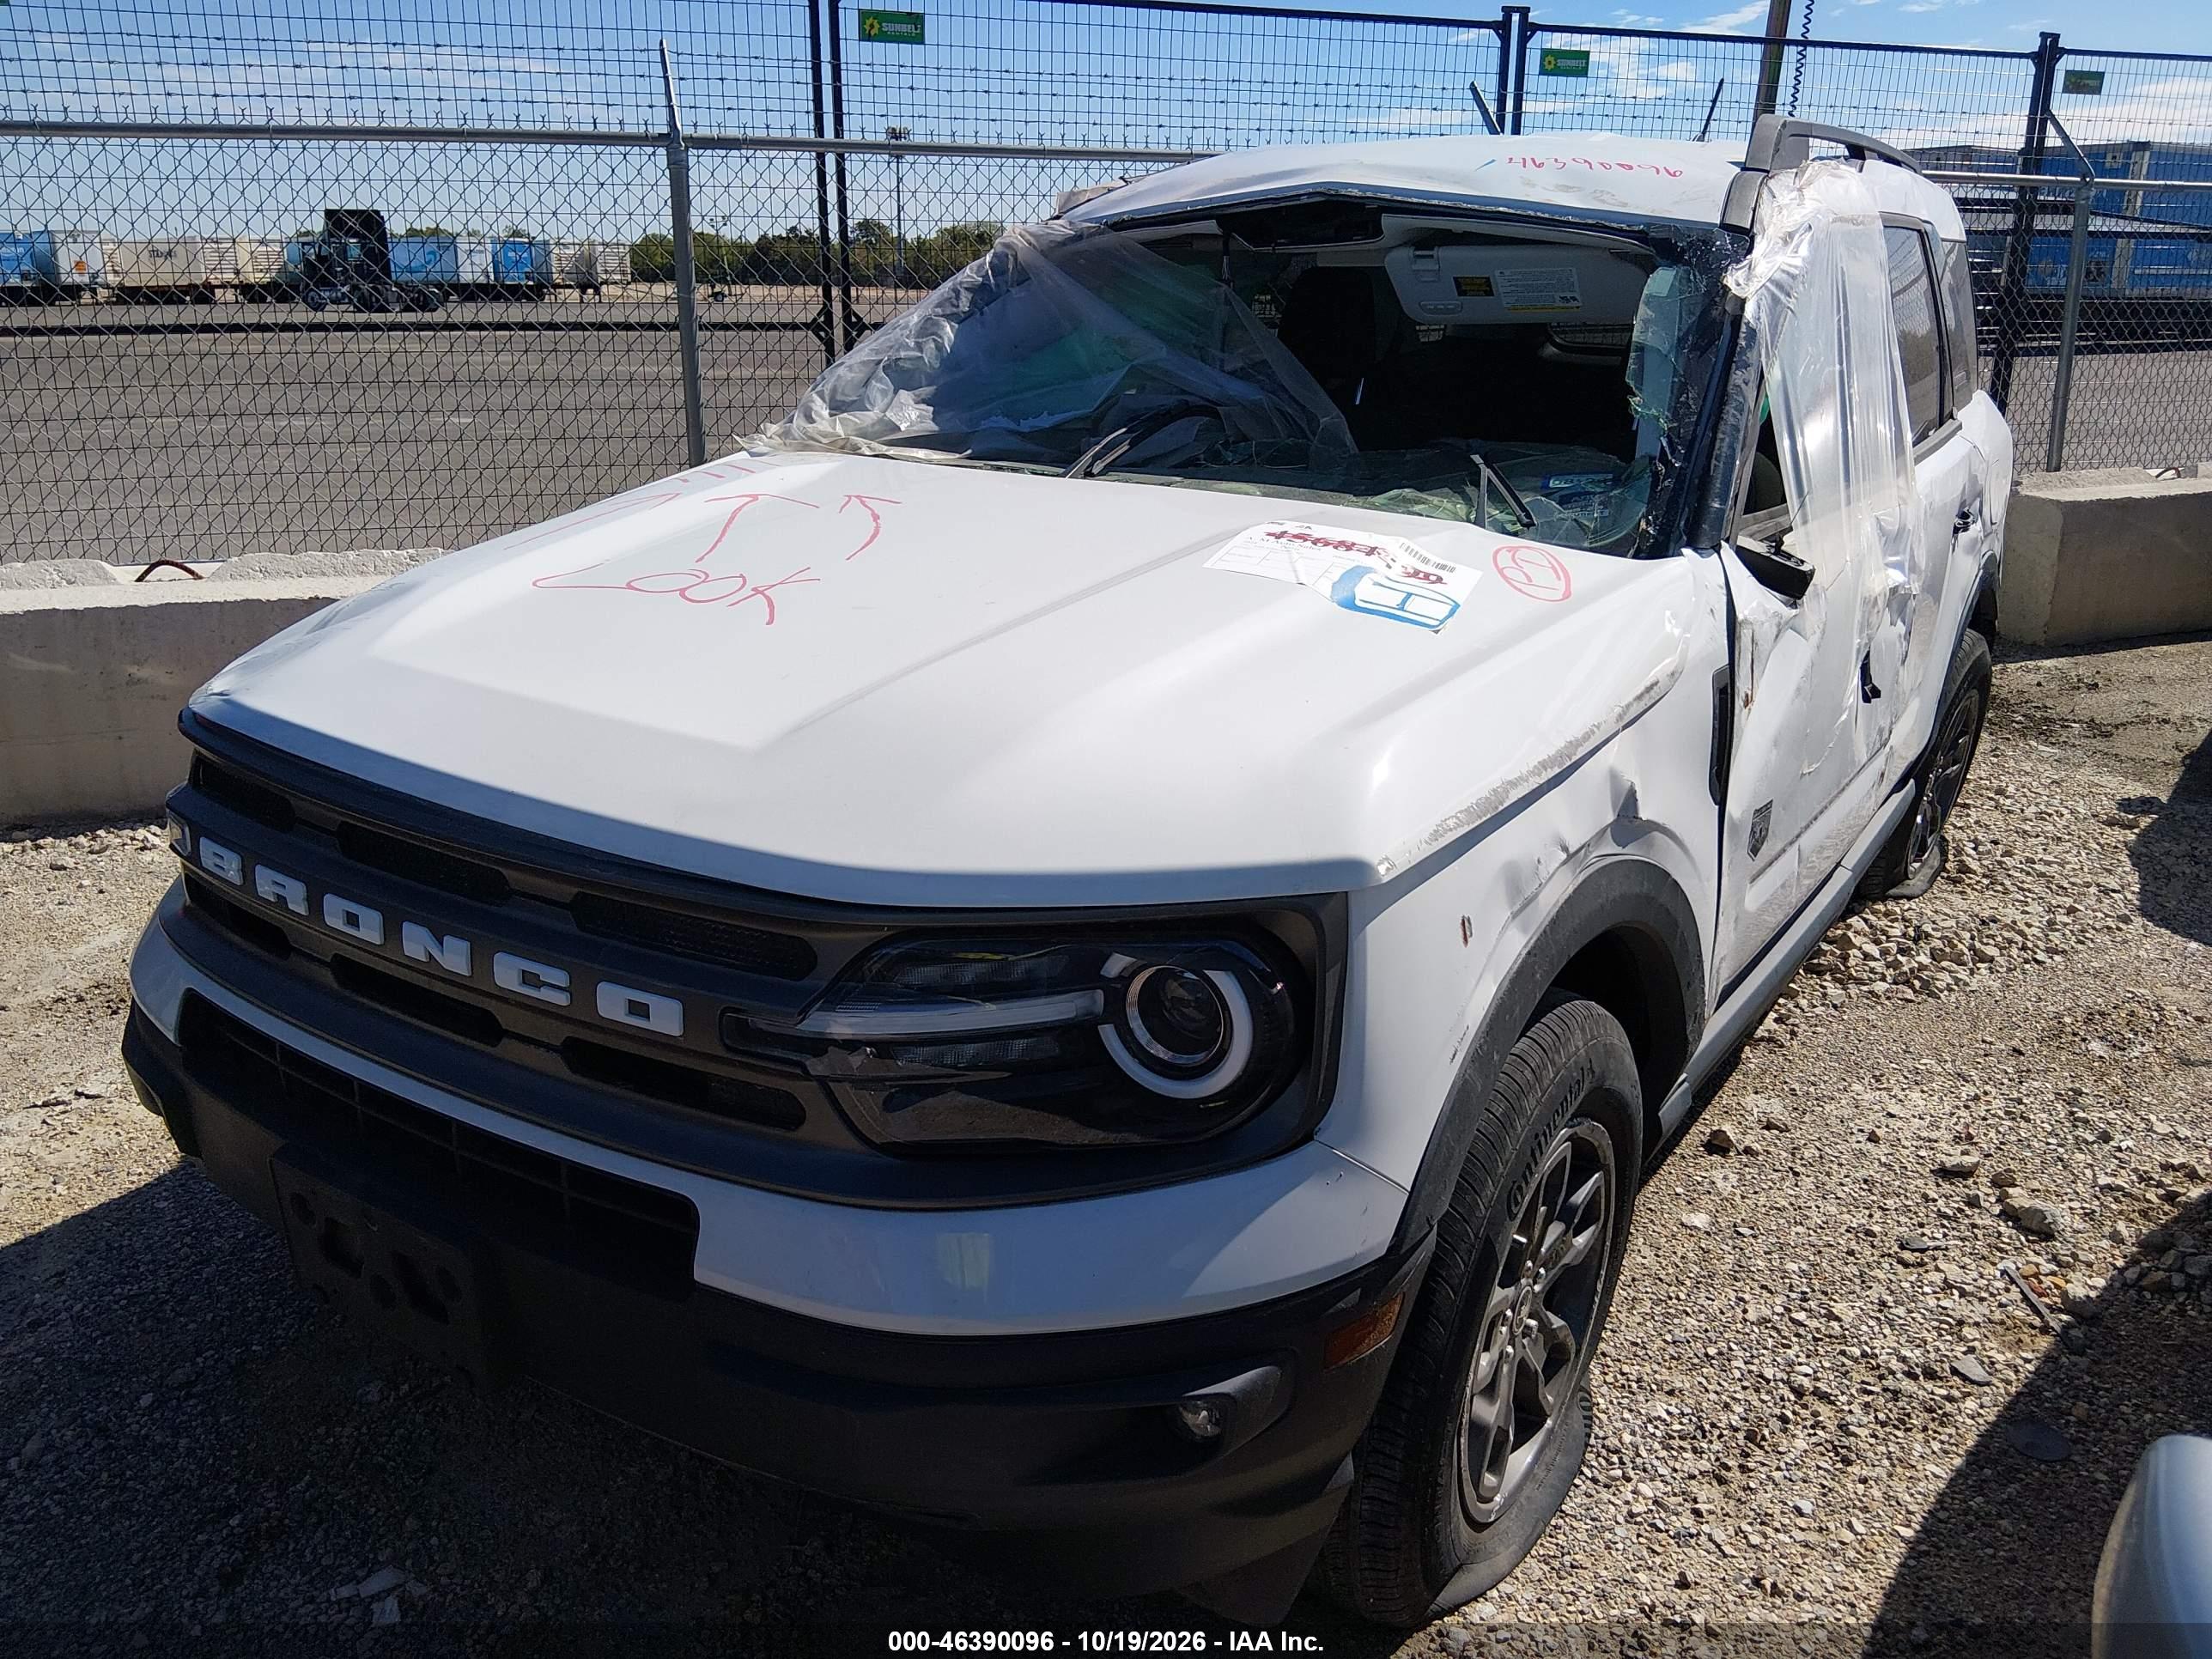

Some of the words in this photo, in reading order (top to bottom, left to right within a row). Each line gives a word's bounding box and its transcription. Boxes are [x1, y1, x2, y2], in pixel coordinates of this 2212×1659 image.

[1506, 157, 1683, 178] 46390096
[532, 567, 821, 625] LOOK
[198, 836, 684, 1037] BRONCO
[1506, 1066, 1585, 1222] Continental
